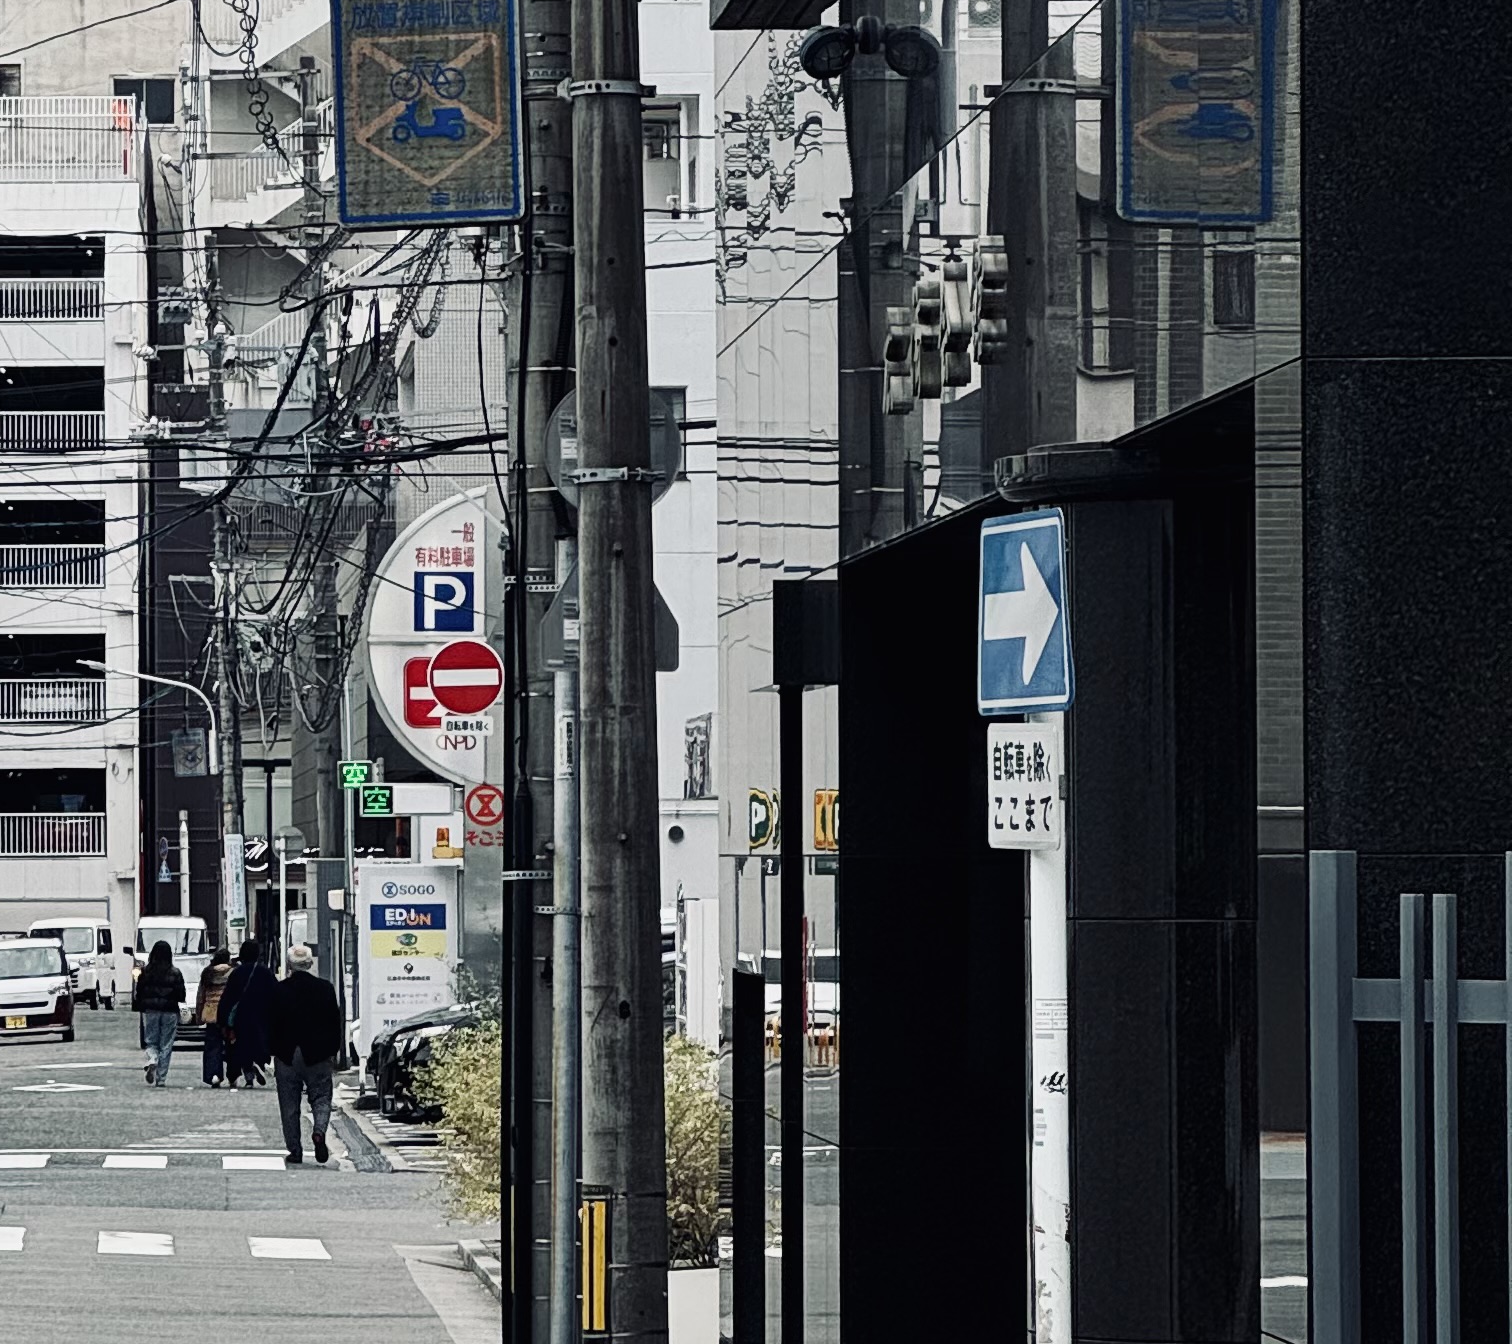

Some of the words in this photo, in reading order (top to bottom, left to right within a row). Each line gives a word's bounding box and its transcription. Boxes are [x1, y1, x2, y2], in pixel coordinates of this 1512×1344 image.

[451, 522, 475, 543] 一般
[415, 546, 475, 568] 有料駐車場
[423, 575, 467, 630] P
[993, 741, 1051, 783] 自転車を除く
[343, 763, 368, 788] 空
[364, 787, 390, 813] 空
[994, 793, 1053, 832] ここまで
[399, 884, 435, 895] SOGO
[384, 908, 432, 926] EDION
